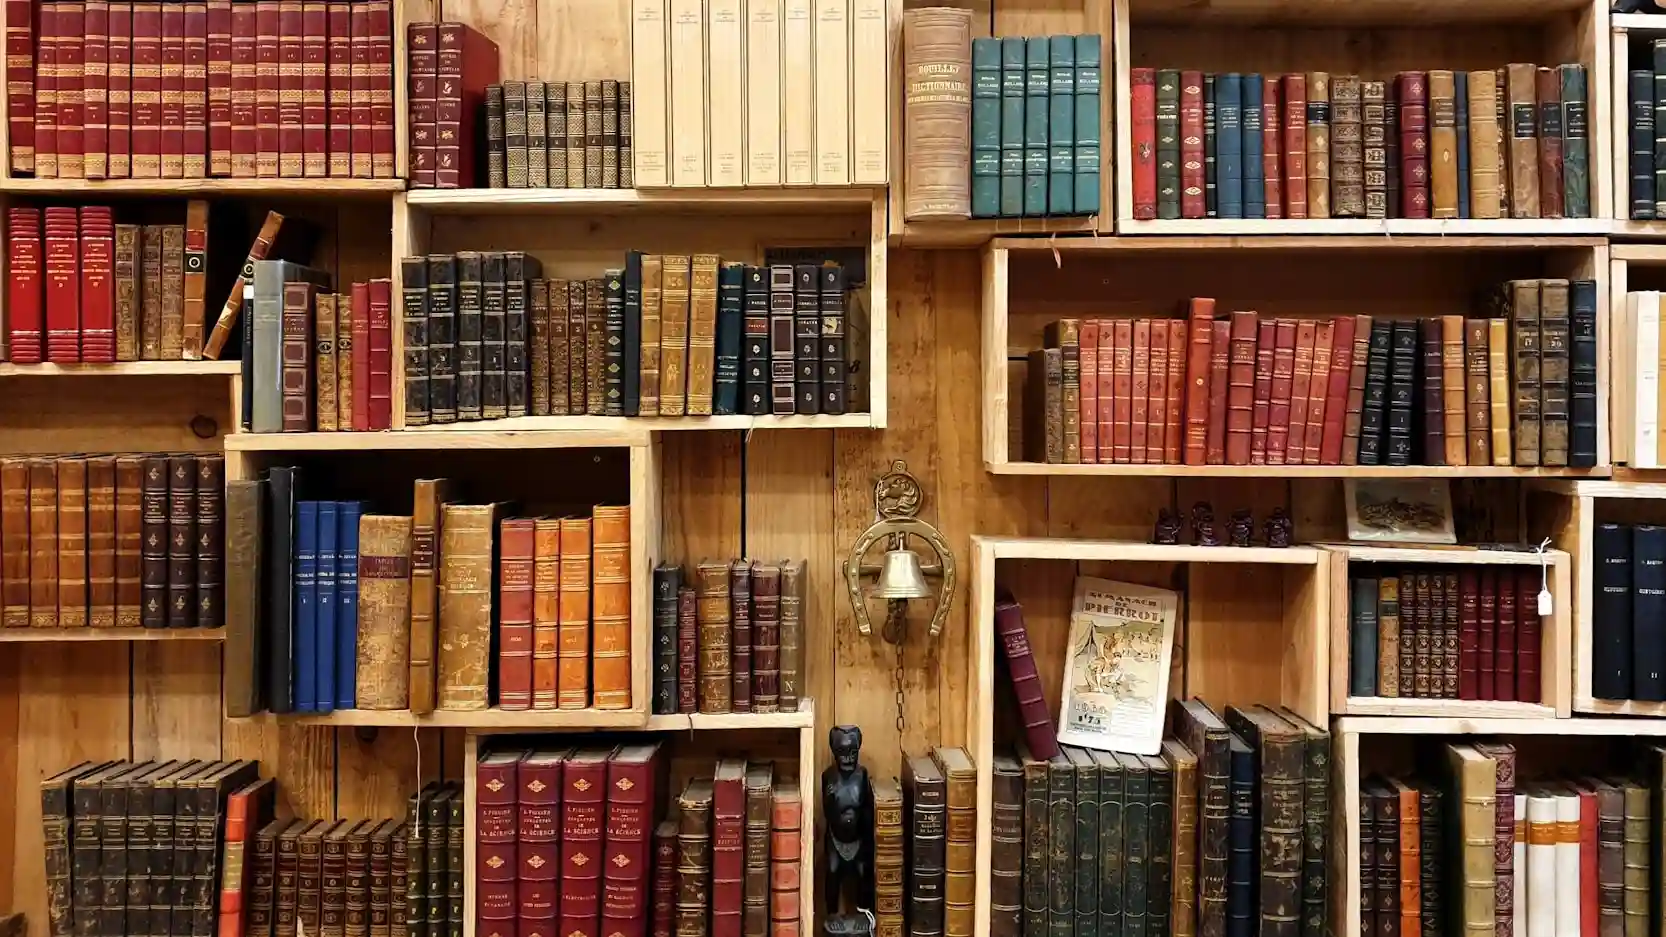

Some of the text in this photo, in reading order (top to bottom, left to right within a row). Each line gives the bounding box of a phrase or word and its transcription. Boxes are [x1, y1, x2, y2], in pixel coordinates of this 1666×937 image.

[785, 681, 793, 692] N
[489, 829, 515, 837] SCIENCE
[615, 828, 641, 836] SCIENCE
